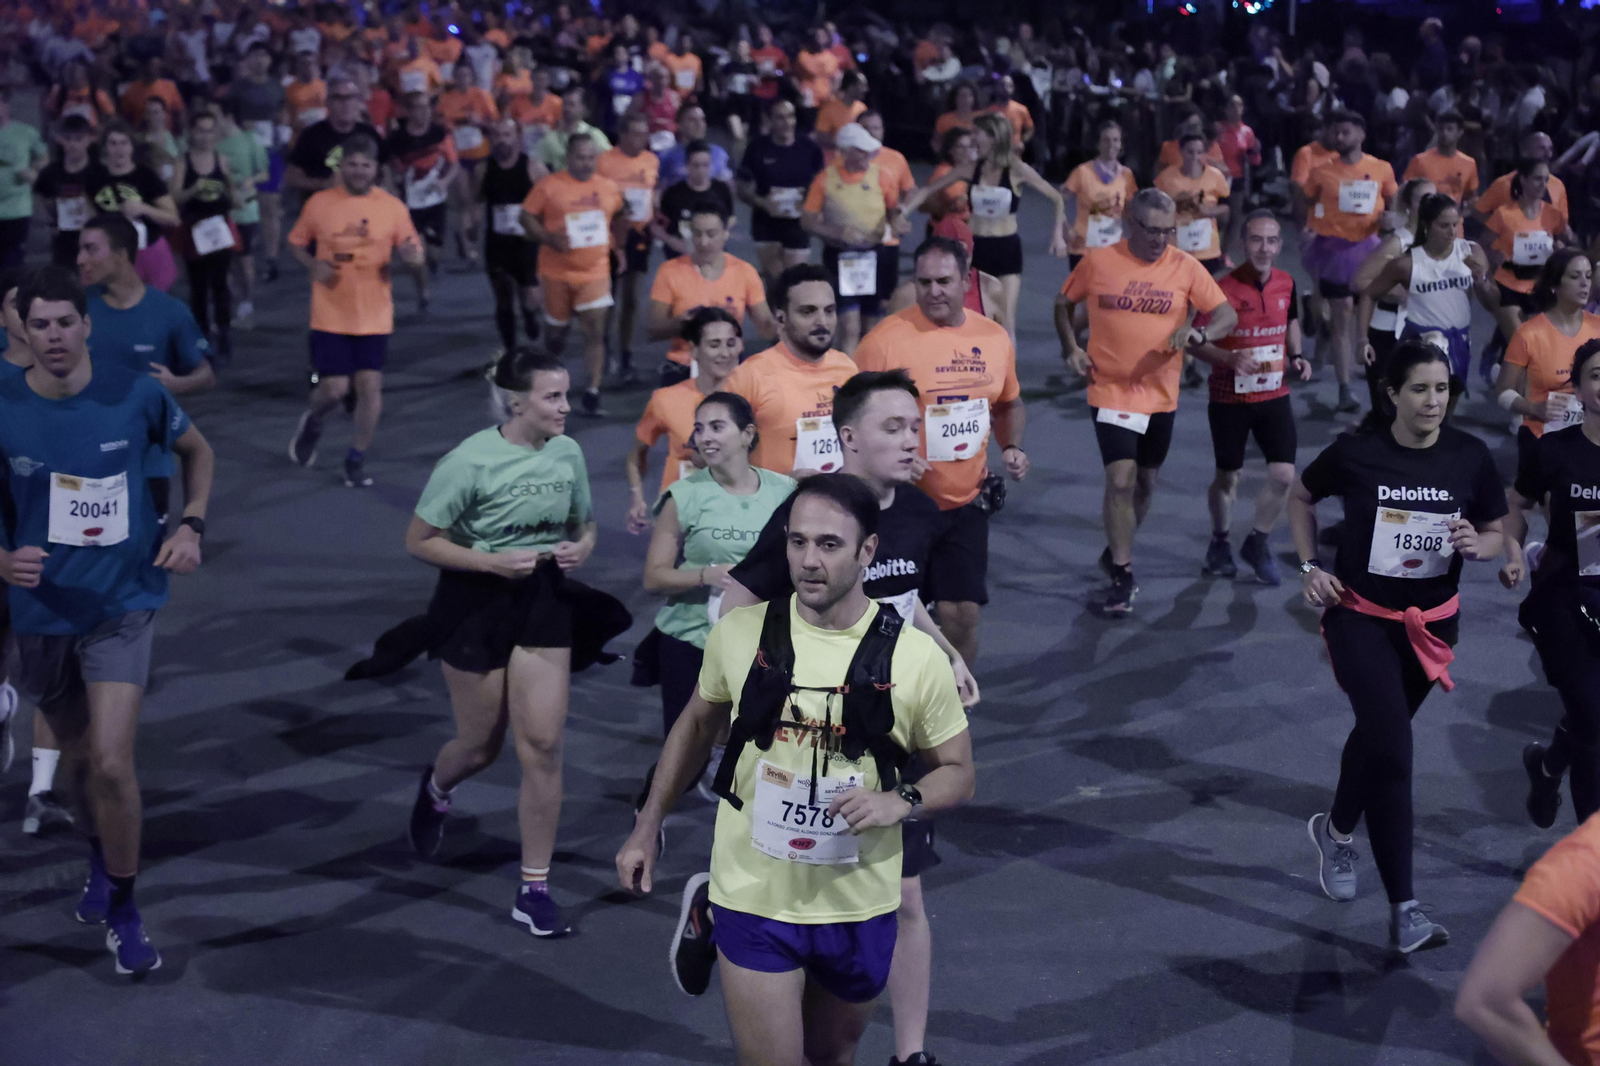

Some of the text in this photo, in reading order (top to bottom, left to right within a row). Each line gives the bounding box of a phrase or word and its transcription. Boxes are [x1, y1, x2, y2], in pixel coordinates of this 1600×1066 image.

[1131, 297, 1172, 315] 2020
[942, 420, 979, 438] 20446
[70, 500, 118, 518] 20041
[1393, 533, 1443, 551] 18308
[782, 800, 834, 828] 7578
